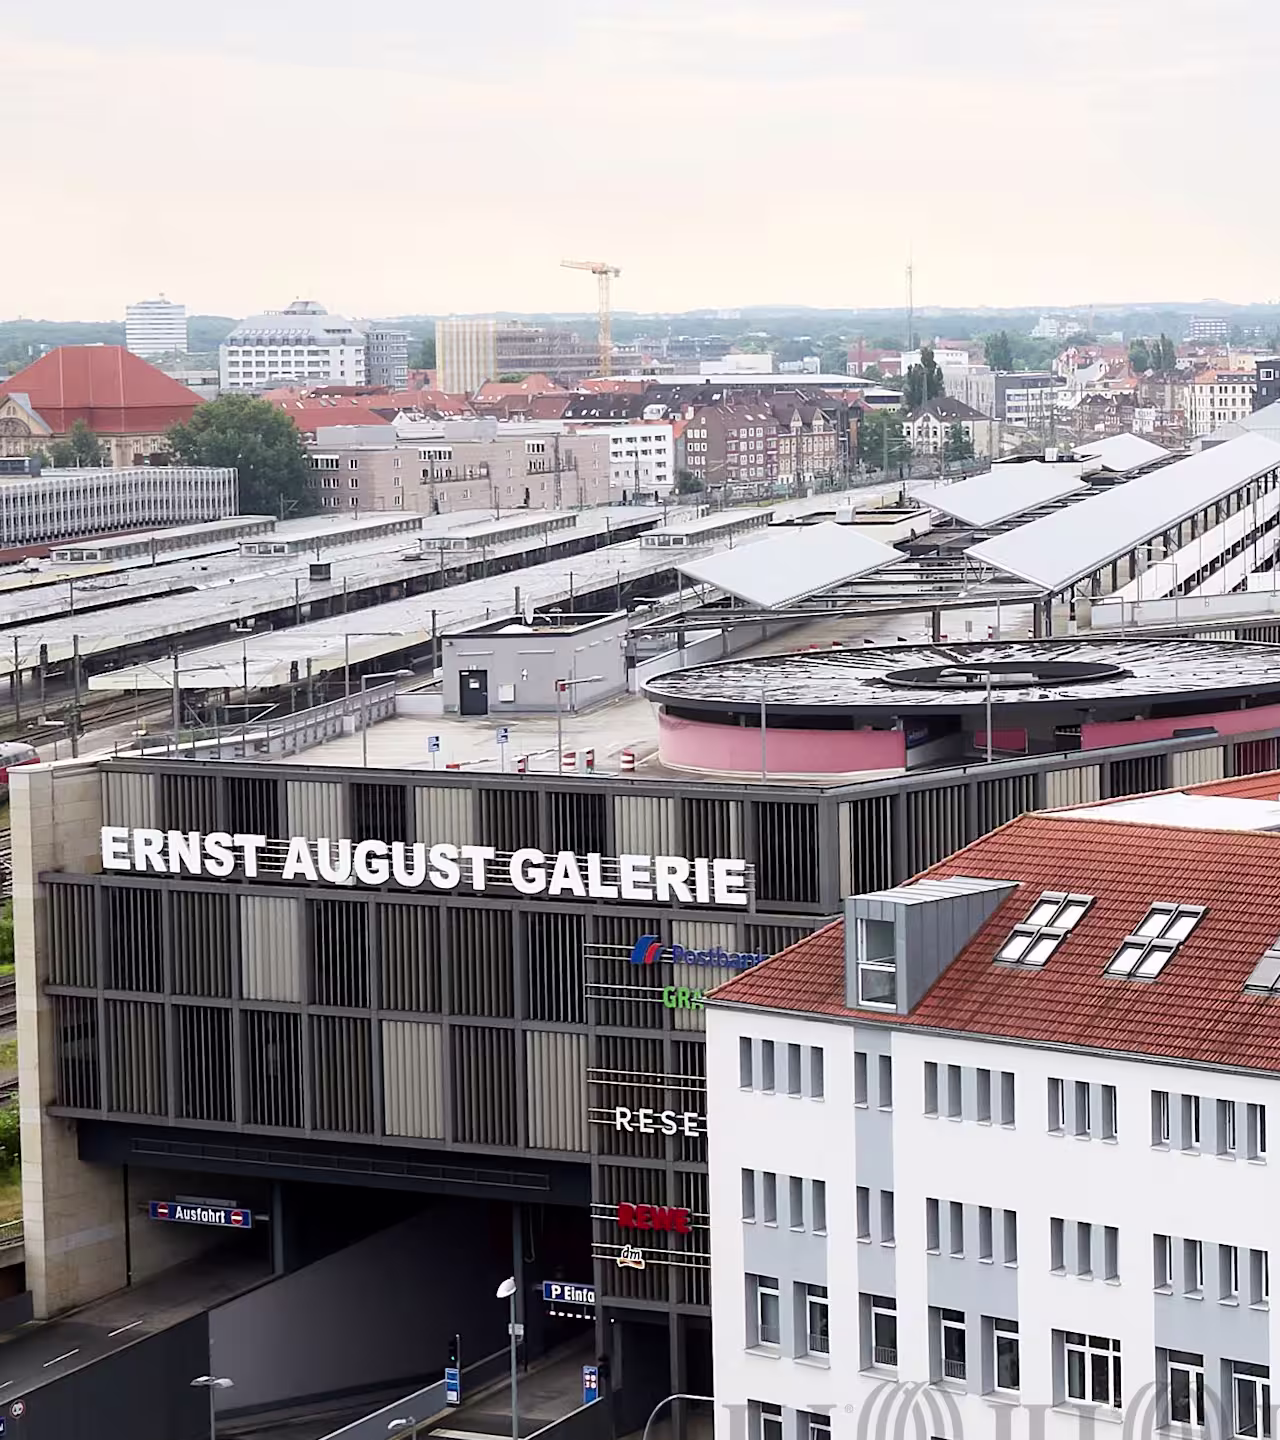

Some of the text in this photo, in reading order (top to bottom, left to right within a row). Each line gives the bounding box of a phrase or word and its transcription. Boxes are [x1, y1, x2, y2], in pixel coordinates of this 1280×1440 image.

[101, 826, 748, 906] ERNST AUGUST GALERIE
[615, 1106, 700, 1137] RESE
[175, 1205, 226, 1224] Ausfahrt
[617, 1202, 692, 1234] REWE
